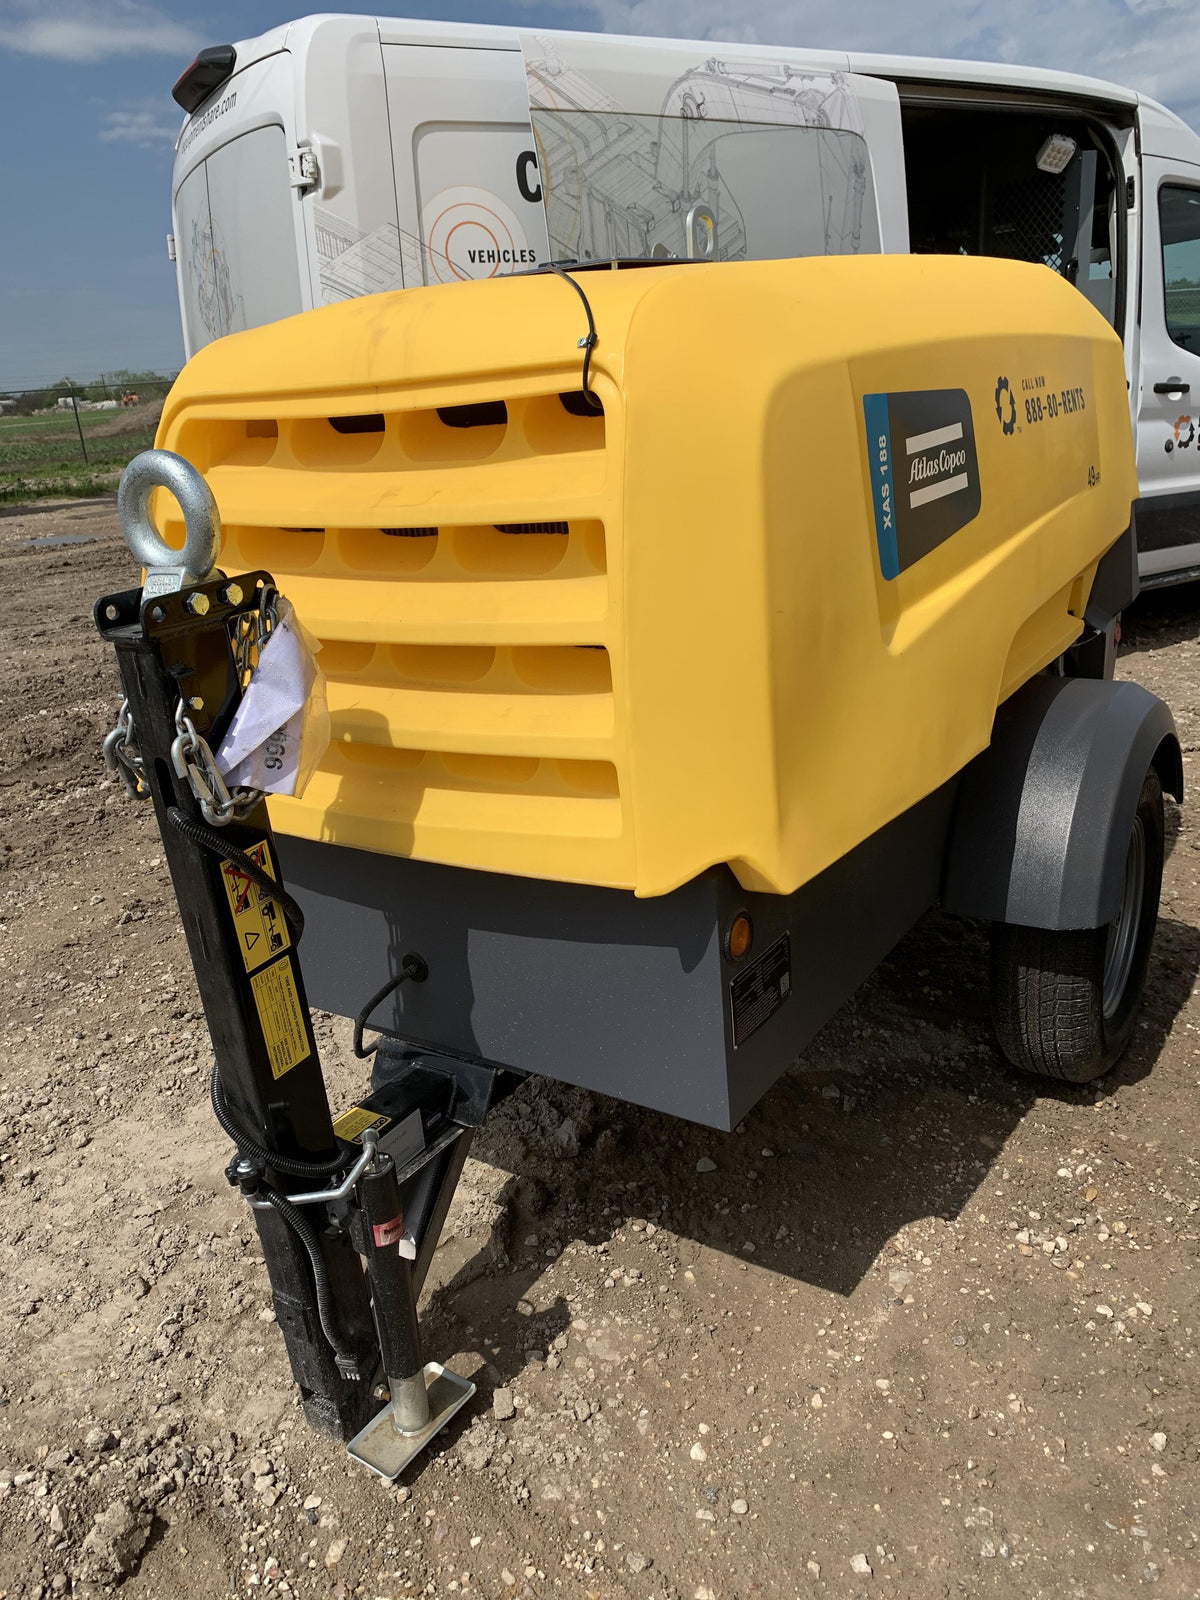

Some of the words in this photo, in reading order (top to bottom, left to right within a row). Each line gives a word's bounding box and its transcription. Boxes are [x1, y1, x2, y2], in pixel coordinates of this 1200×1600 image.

[468, 249, 536, 263] VEHICLES
[1022, 377, 1034, 391] CALL
[1035, 375, 1046, 389] NOW
[1025, 387, 1086, 425] 888-80-RENTS
[878, 434, 889, 476] 188
[908, 455, 940, 484] Atlas
[939, 449, 966, 474] Copco
[881, 483, 893, 531] XAS
